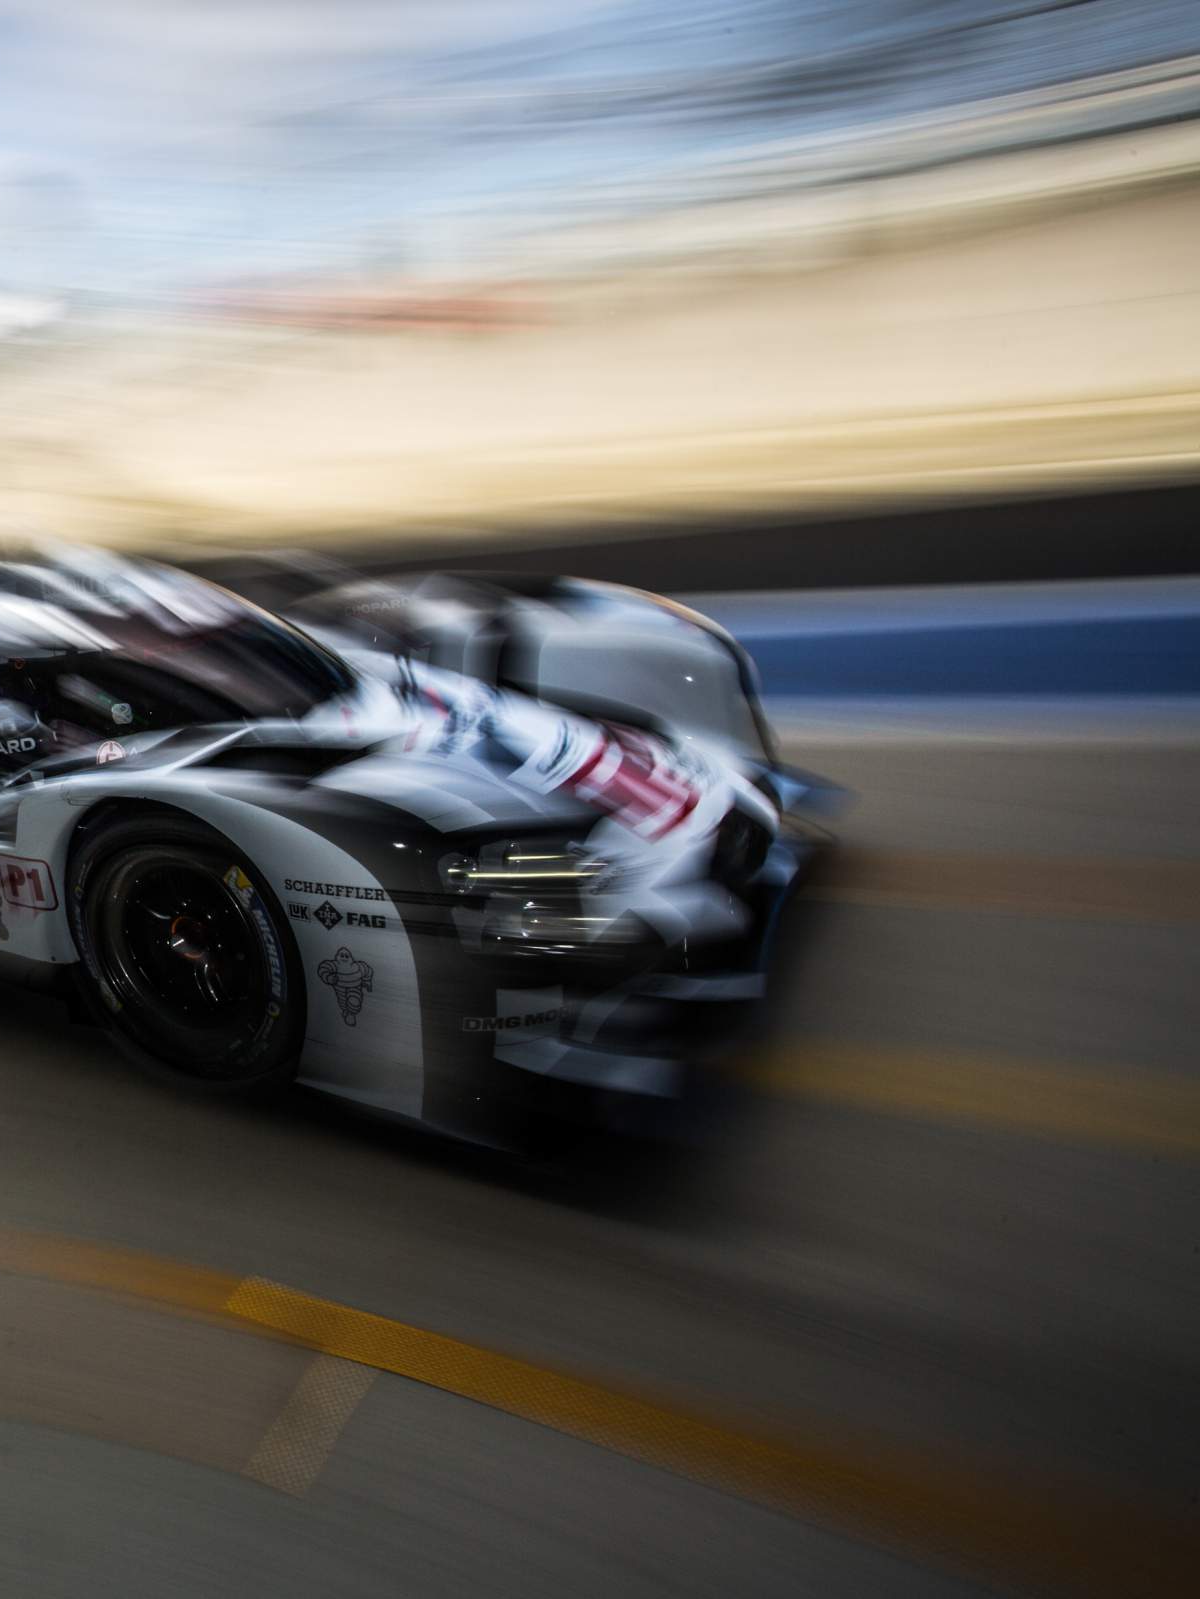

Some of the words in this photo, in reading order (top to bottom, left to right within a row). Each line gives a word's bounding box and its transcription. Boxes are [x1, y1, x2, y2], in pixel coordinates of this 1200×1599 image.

[7, 864, 45, 902] P1
[284, 879, 386, 901] SCHAEFFLER
[347, 912, 386, 929] FAG
[252, 908, 282, 998] MICHELIN
[463, 1016, 521, 1032] DMG
